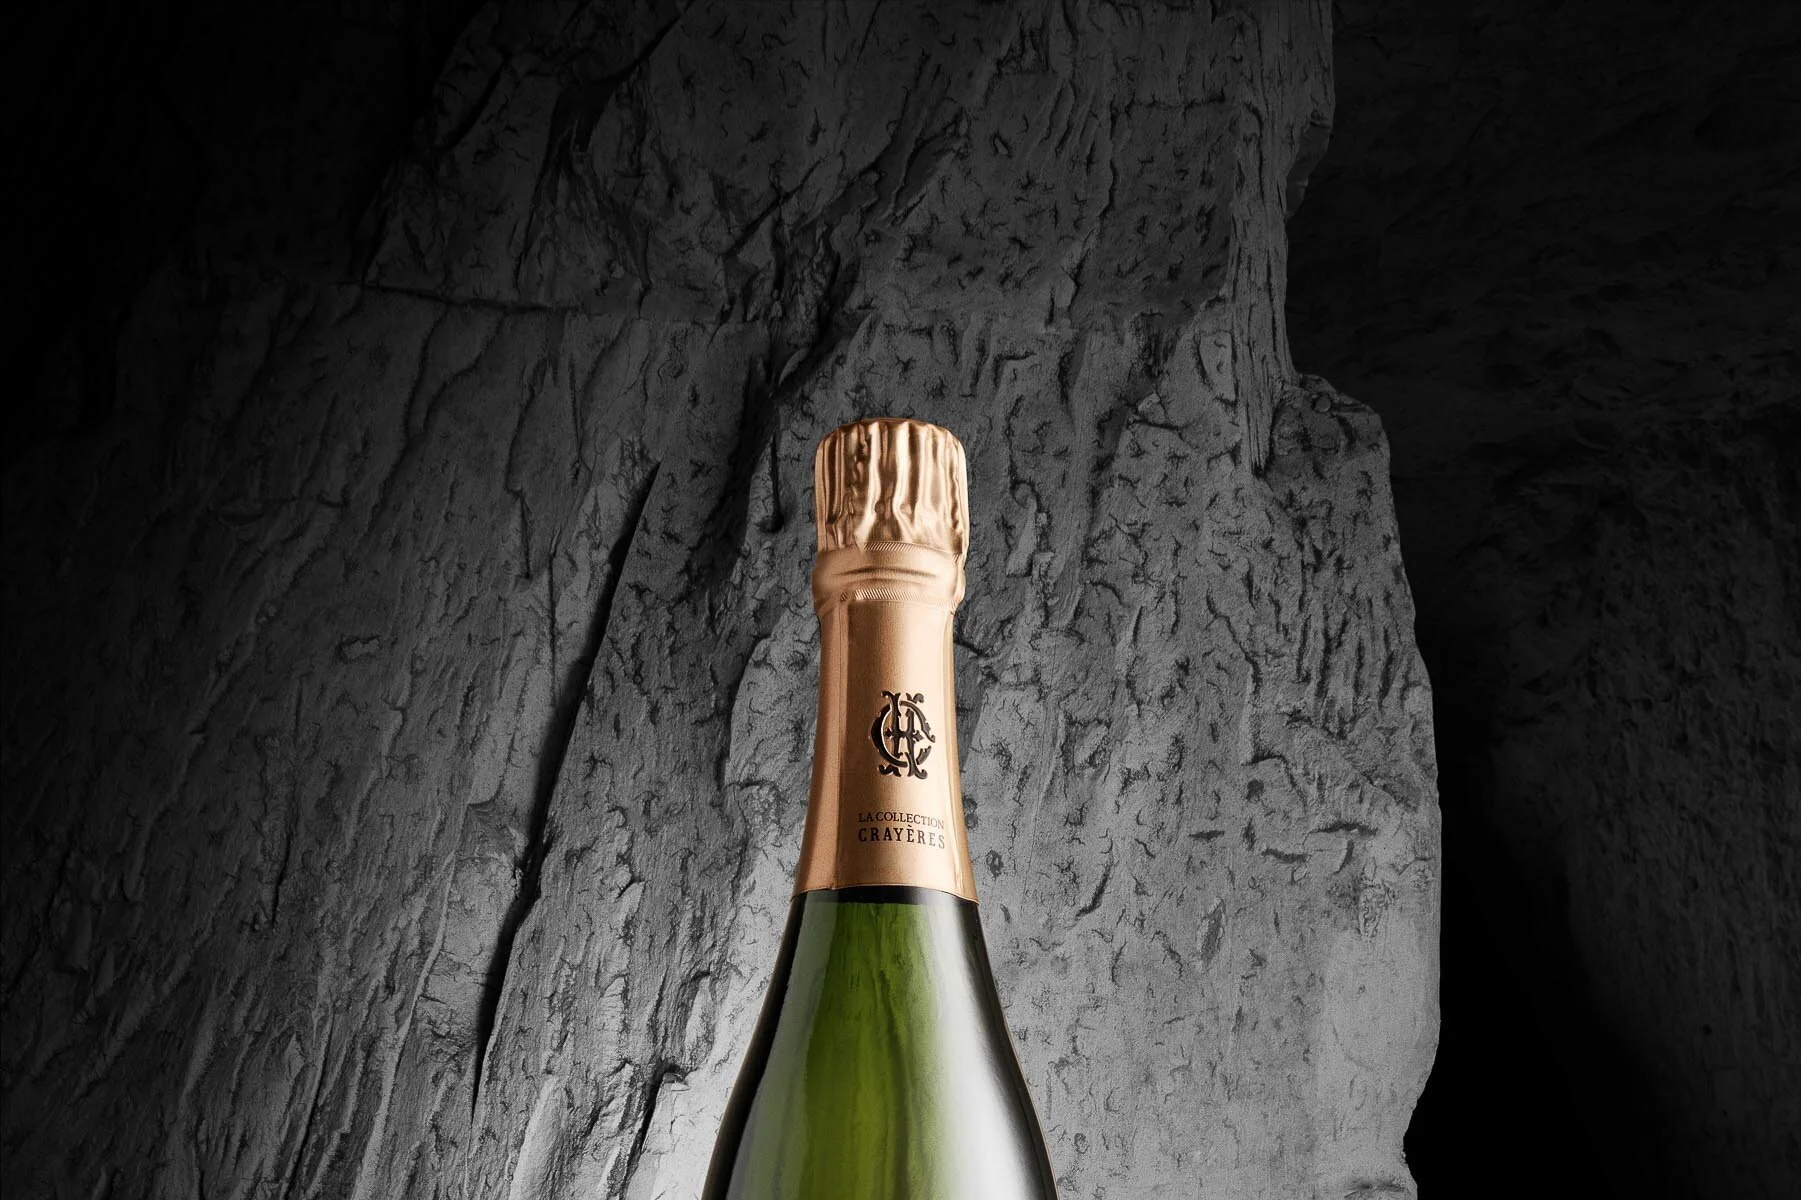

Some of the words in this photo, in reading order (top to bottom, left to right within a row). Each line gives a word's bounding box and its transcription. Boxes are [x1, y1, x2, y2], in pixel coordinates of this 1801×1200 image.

[858, 812, 874, 823] LA
[875, 811, 945, 829] COLLECTION
[858, 824, 945, 849] CRAYÈRES
